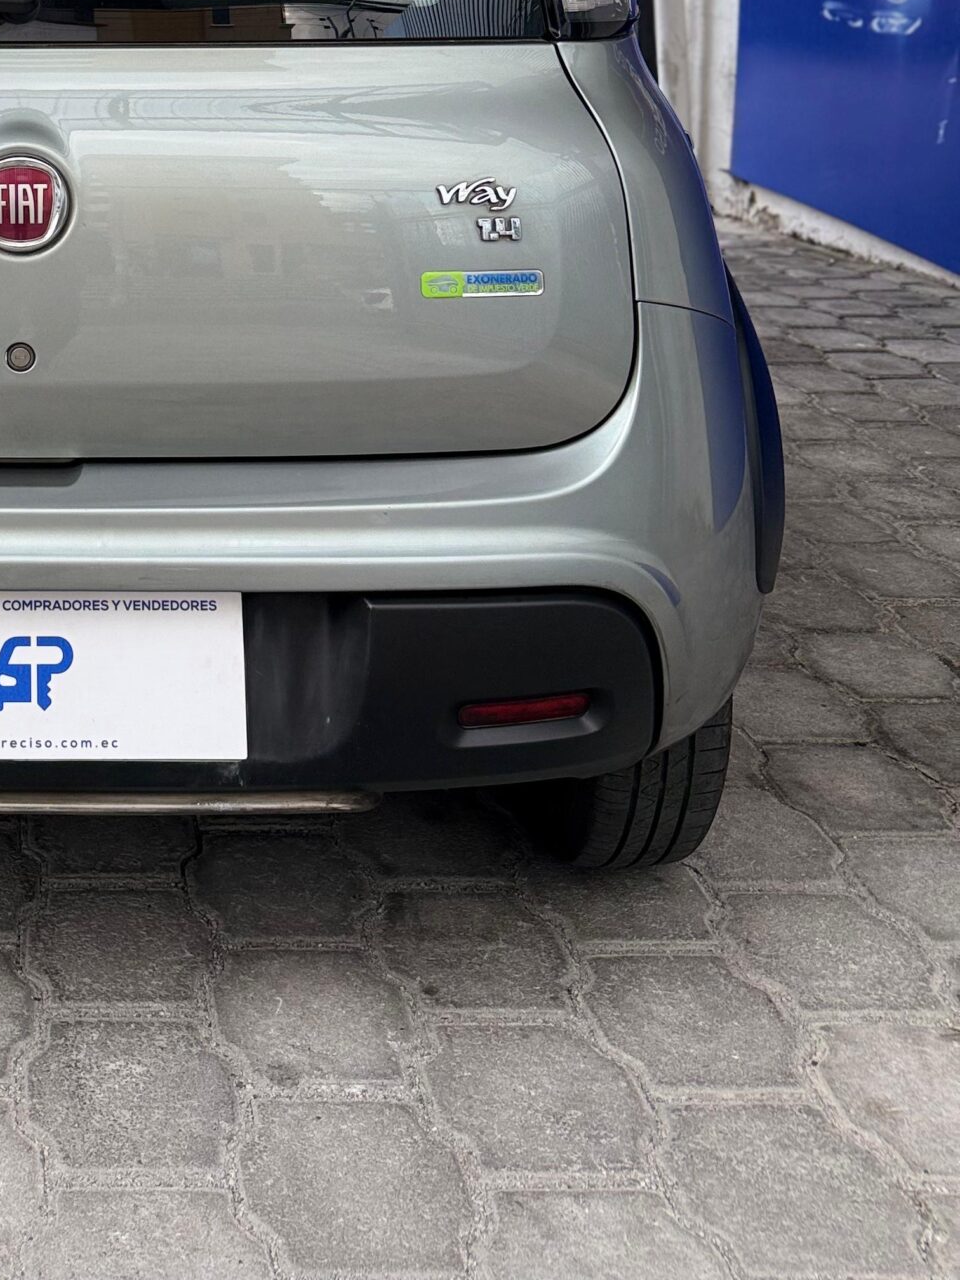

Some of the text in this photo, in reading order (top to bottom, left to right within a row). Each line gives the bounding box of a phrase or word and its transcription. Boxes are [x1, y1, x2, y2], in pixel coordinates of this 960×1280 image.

[477, 217, 521, 241] 1.4
[467, 273, 538, 284] EXONERADO
[468, 285, 478, 293] DE
[480, 284, 515, 293] IMPUESTO
[2, 600, 109, 612] COMPRADORES
[112, 600, 121, 612] Y
[123, 600, 217, 612] VENDEDORES
